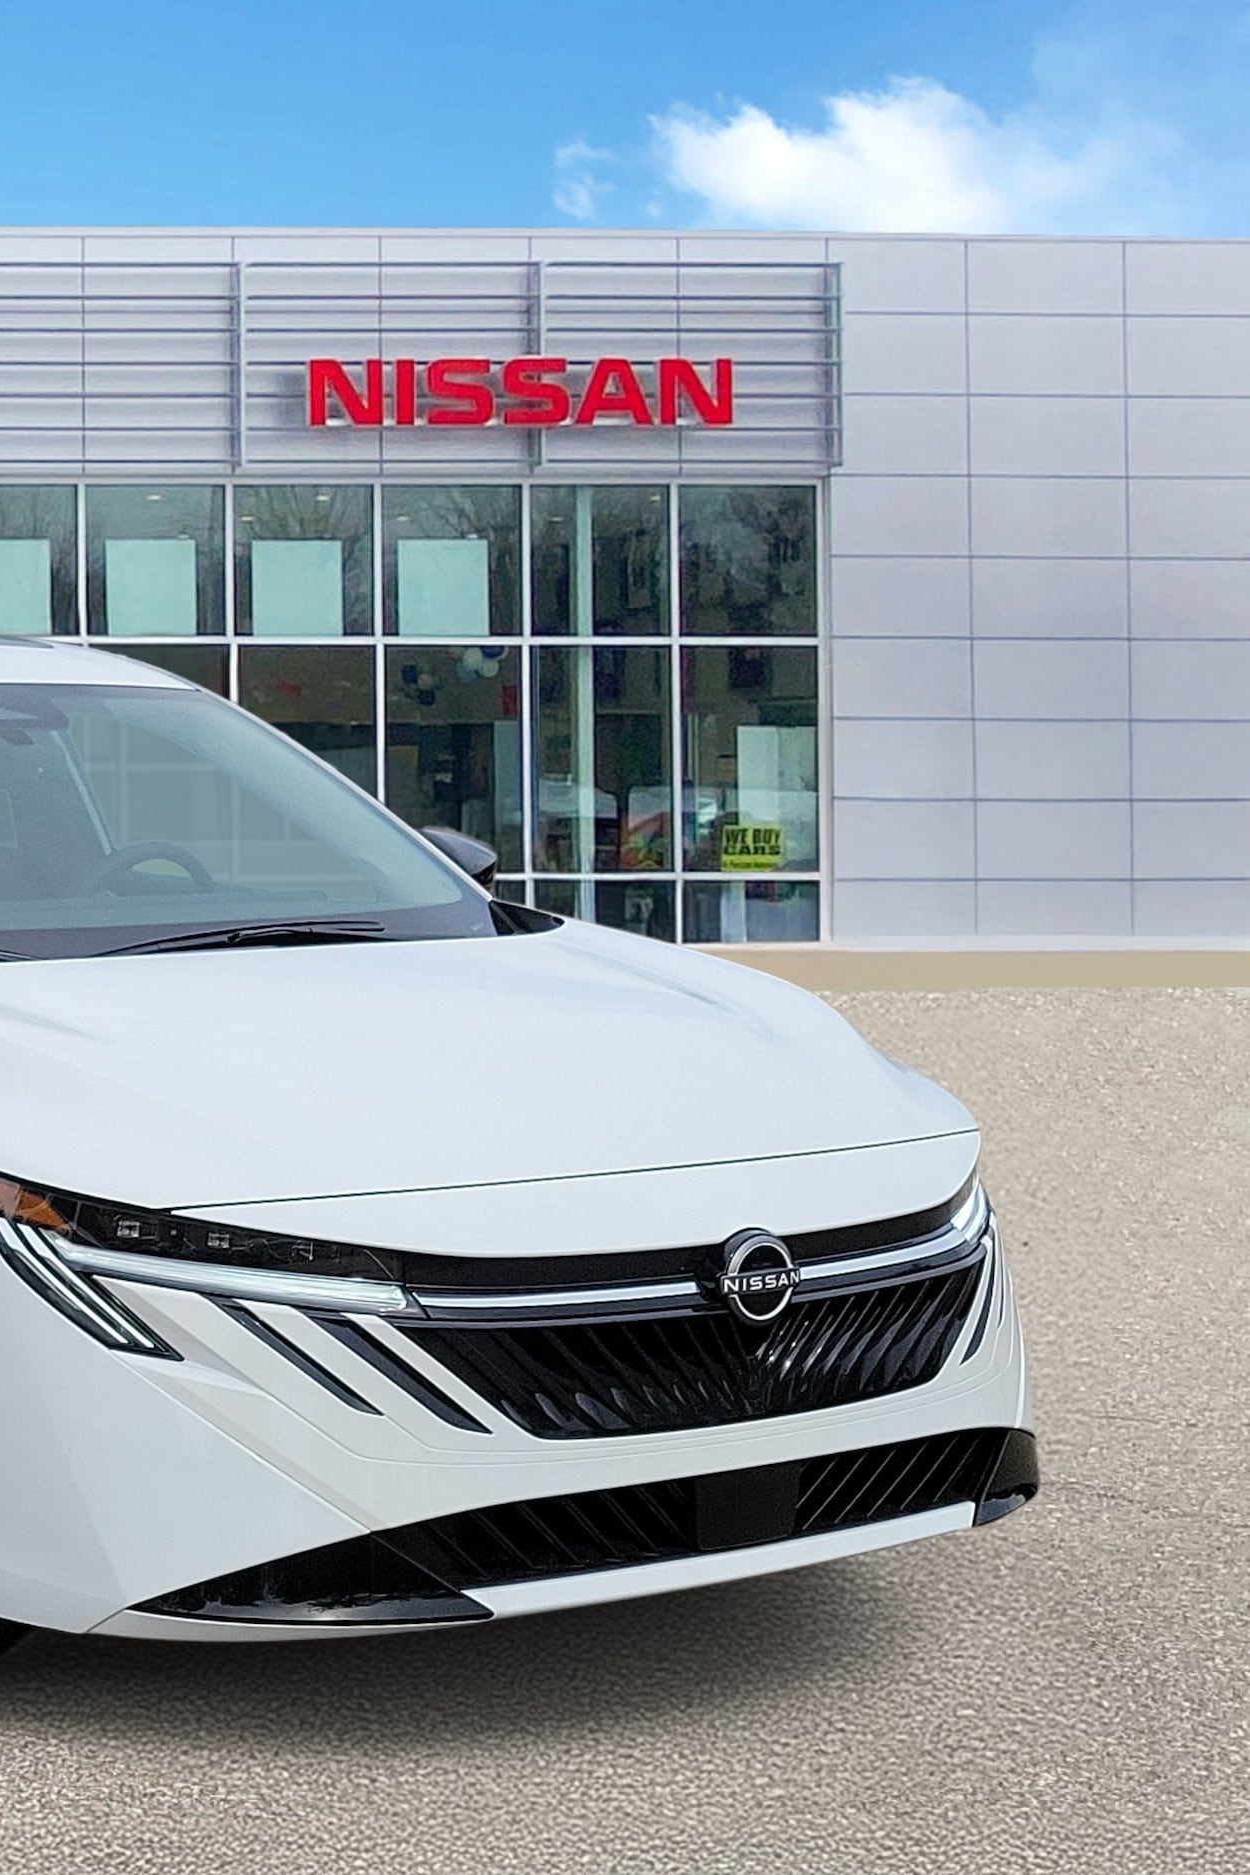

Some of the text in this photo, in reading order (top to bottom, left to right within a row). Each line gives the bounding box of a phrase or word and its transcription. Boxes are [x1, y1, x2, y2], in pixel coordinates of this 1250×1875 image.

[308, 358, 734, 426] NISSAN
[725, 828, 782, 844] WE BUY
[723, 845, 781, 855] CARS
[724, 1270, 800, 1292] NISSAN
